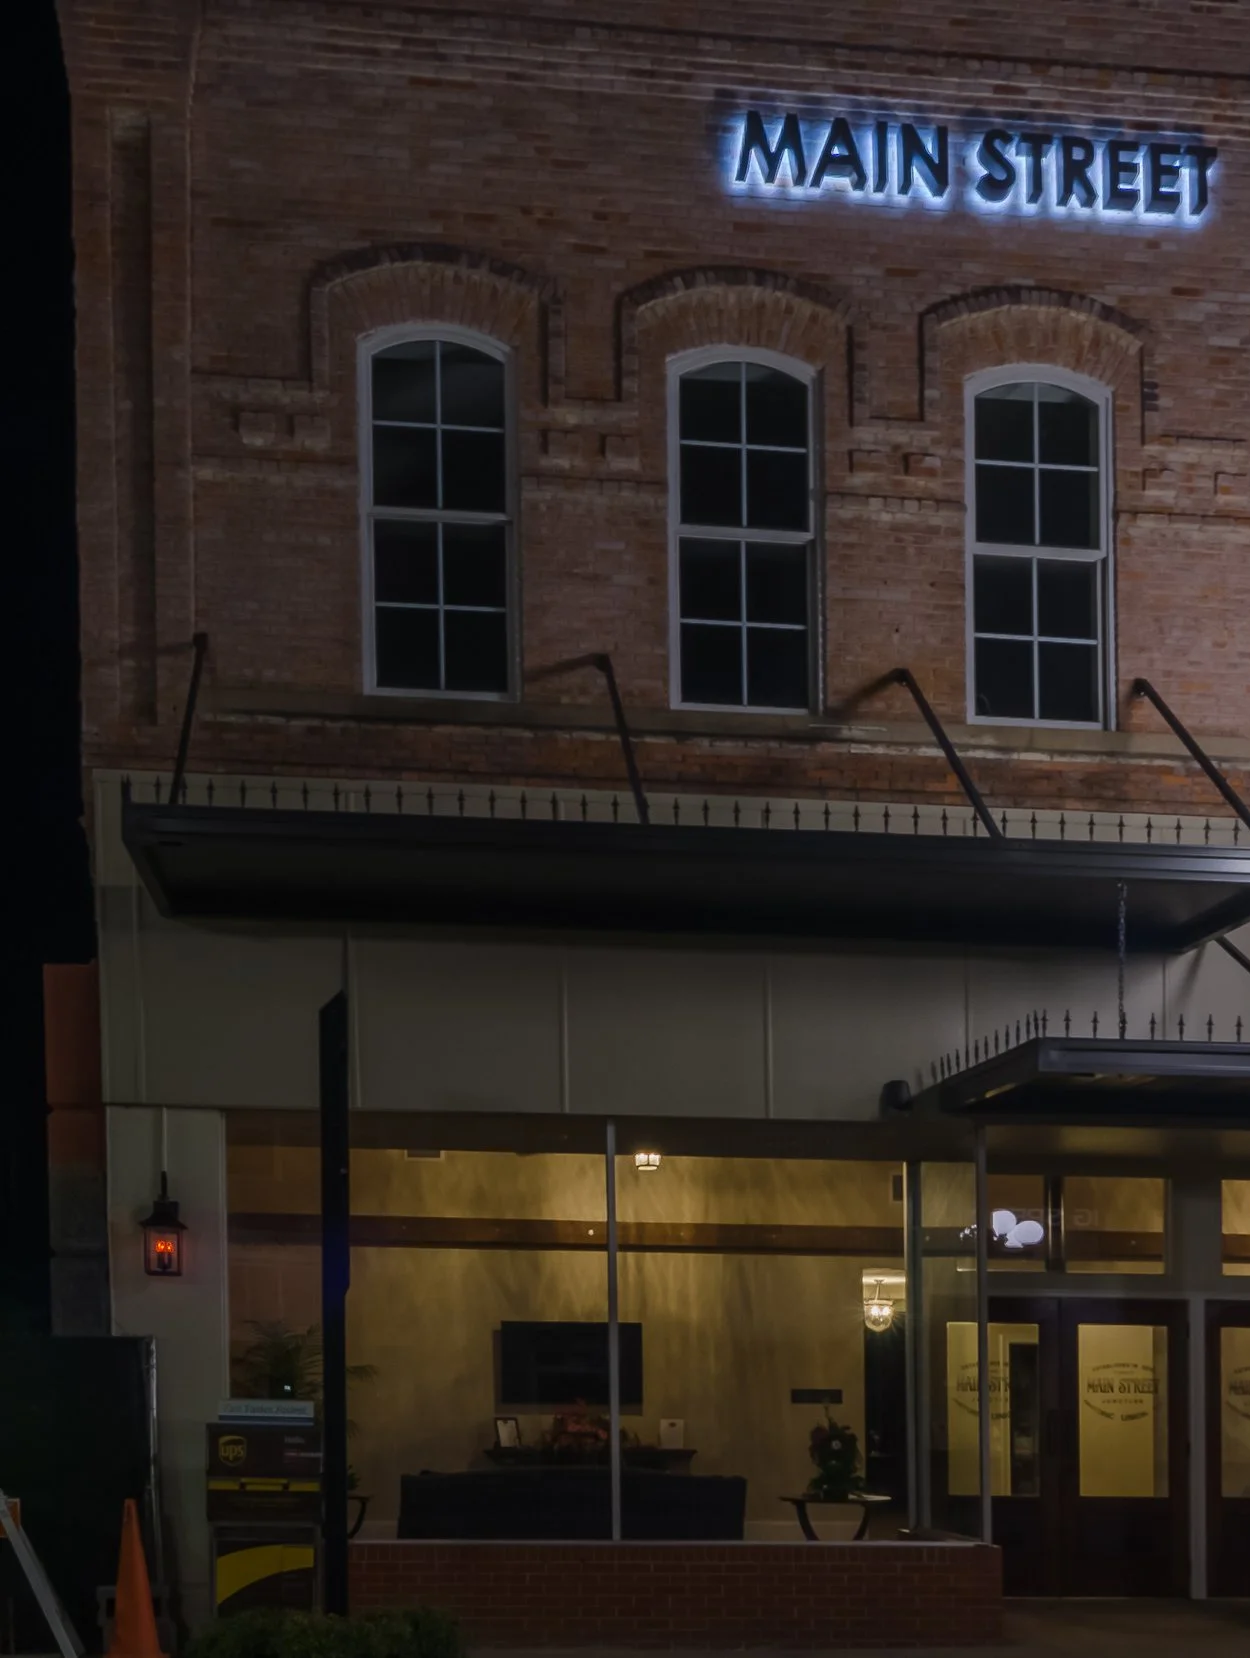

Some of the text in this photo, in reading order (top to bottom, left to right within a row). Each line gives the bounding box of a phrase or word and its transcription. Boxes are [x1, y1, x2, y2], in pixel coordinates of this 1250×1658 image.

[734, 110, 1218, 216] MAIN STREET
[1086, 1377, 1159, 1394] MAIN STREET
[221, 1444, 245, 1461] ups
